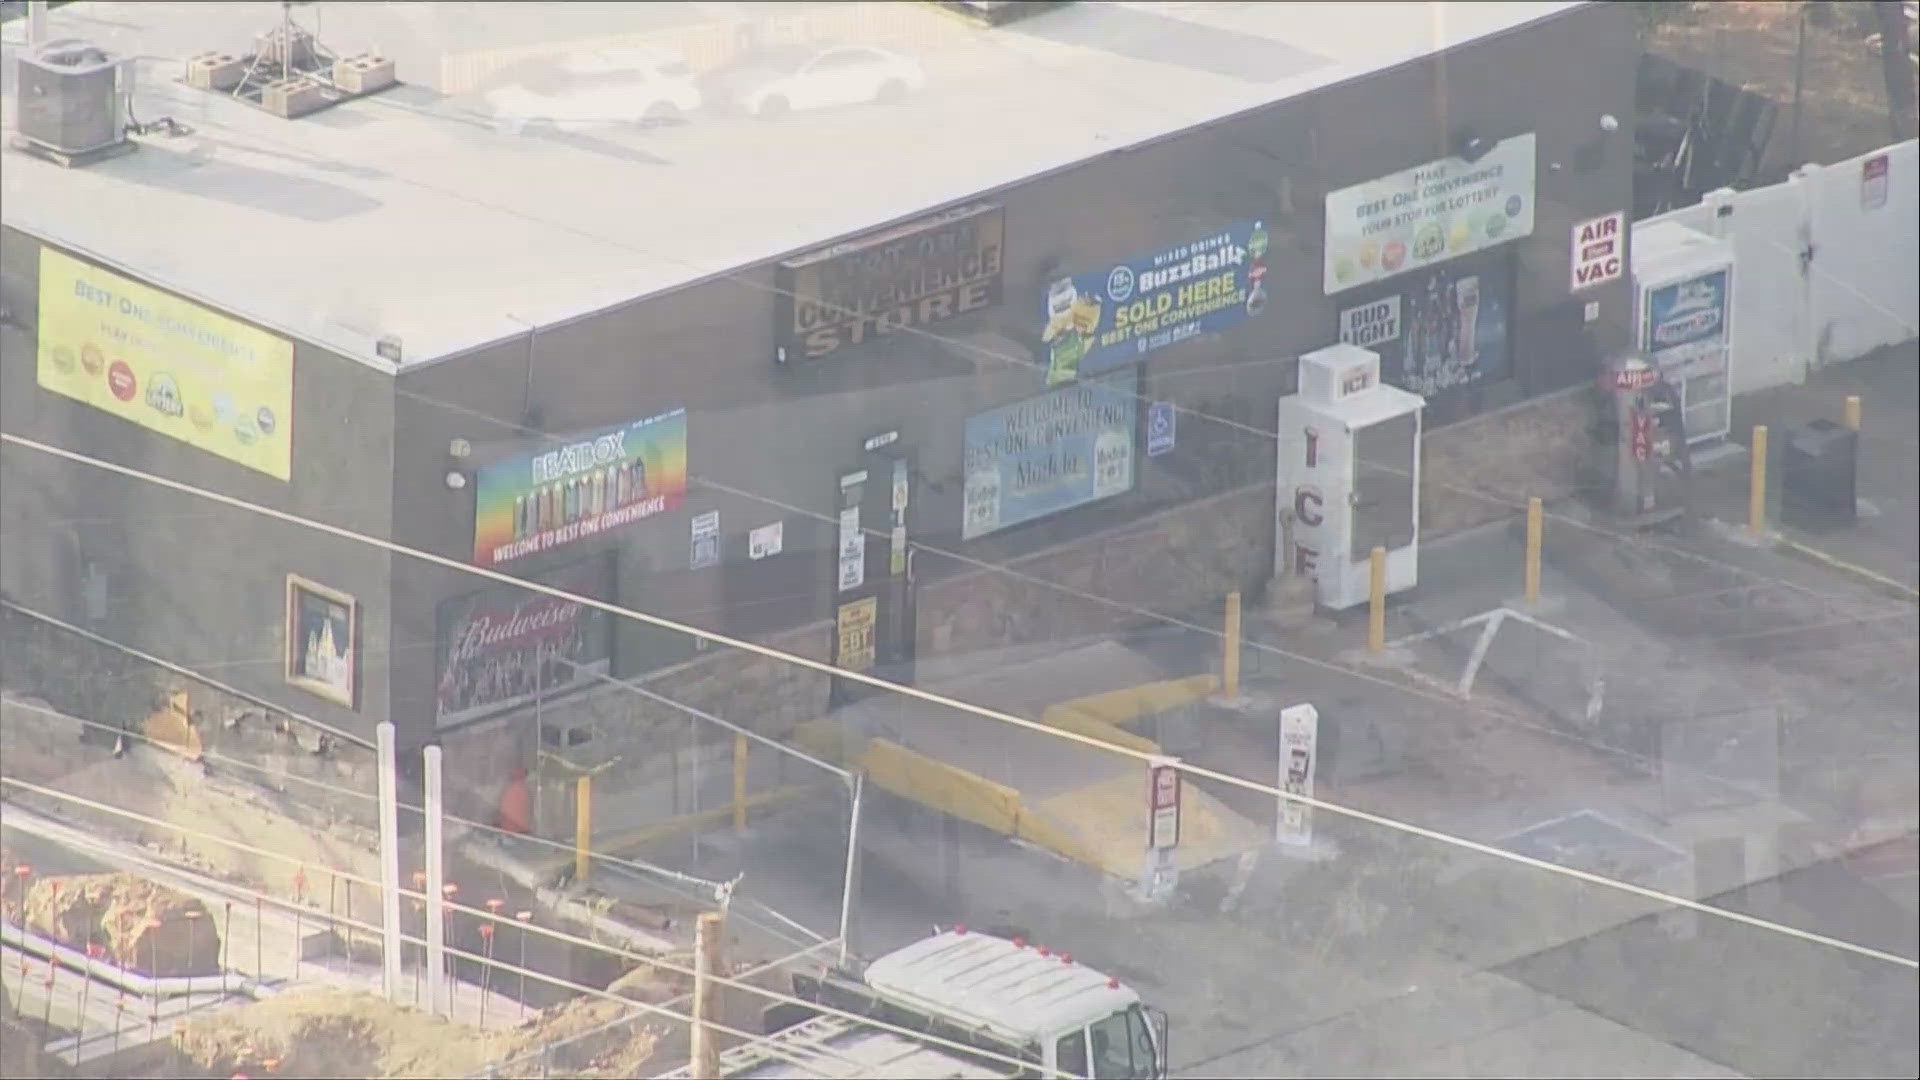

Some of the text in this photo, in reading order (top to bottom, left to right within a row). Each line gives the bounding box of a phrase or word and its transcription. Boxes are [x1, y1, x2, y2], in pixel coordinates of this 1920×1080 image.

[1356, 164, 1505, 218] BEST ONE CONVENIENCE
[1361, 218, 1391, 237] YOUR
[1393, 208, 1421, 227] STOP
[1449, 186, 1499, 210] LOTTERY
[1153, 232, 1232, 266] MIXED DRINKS
[1580, 217, 1617, 243] AIR
[74, 278, 112, 308] BEST
[1576, 258, 1619, 284] VAC
[803, 284, 991, 357] STORE
[1101, 326, 1132, 346] BEST
[1134, 320, 1159, 336] ONE
[1161, 288, 1246, 326] CONVENIENCE
[1114, 272, 1236, 329] SOLD HERE
[1351, 302, 1390, 328] BUD
[1343, 372, 1368, 396] ICE
[1294, 424, 1323, 583] ICE
[492, 495, 666, 564] WELCOME TO BEST ONE CONVENIENCE
[467, 601, 583, 646] Budweiser
